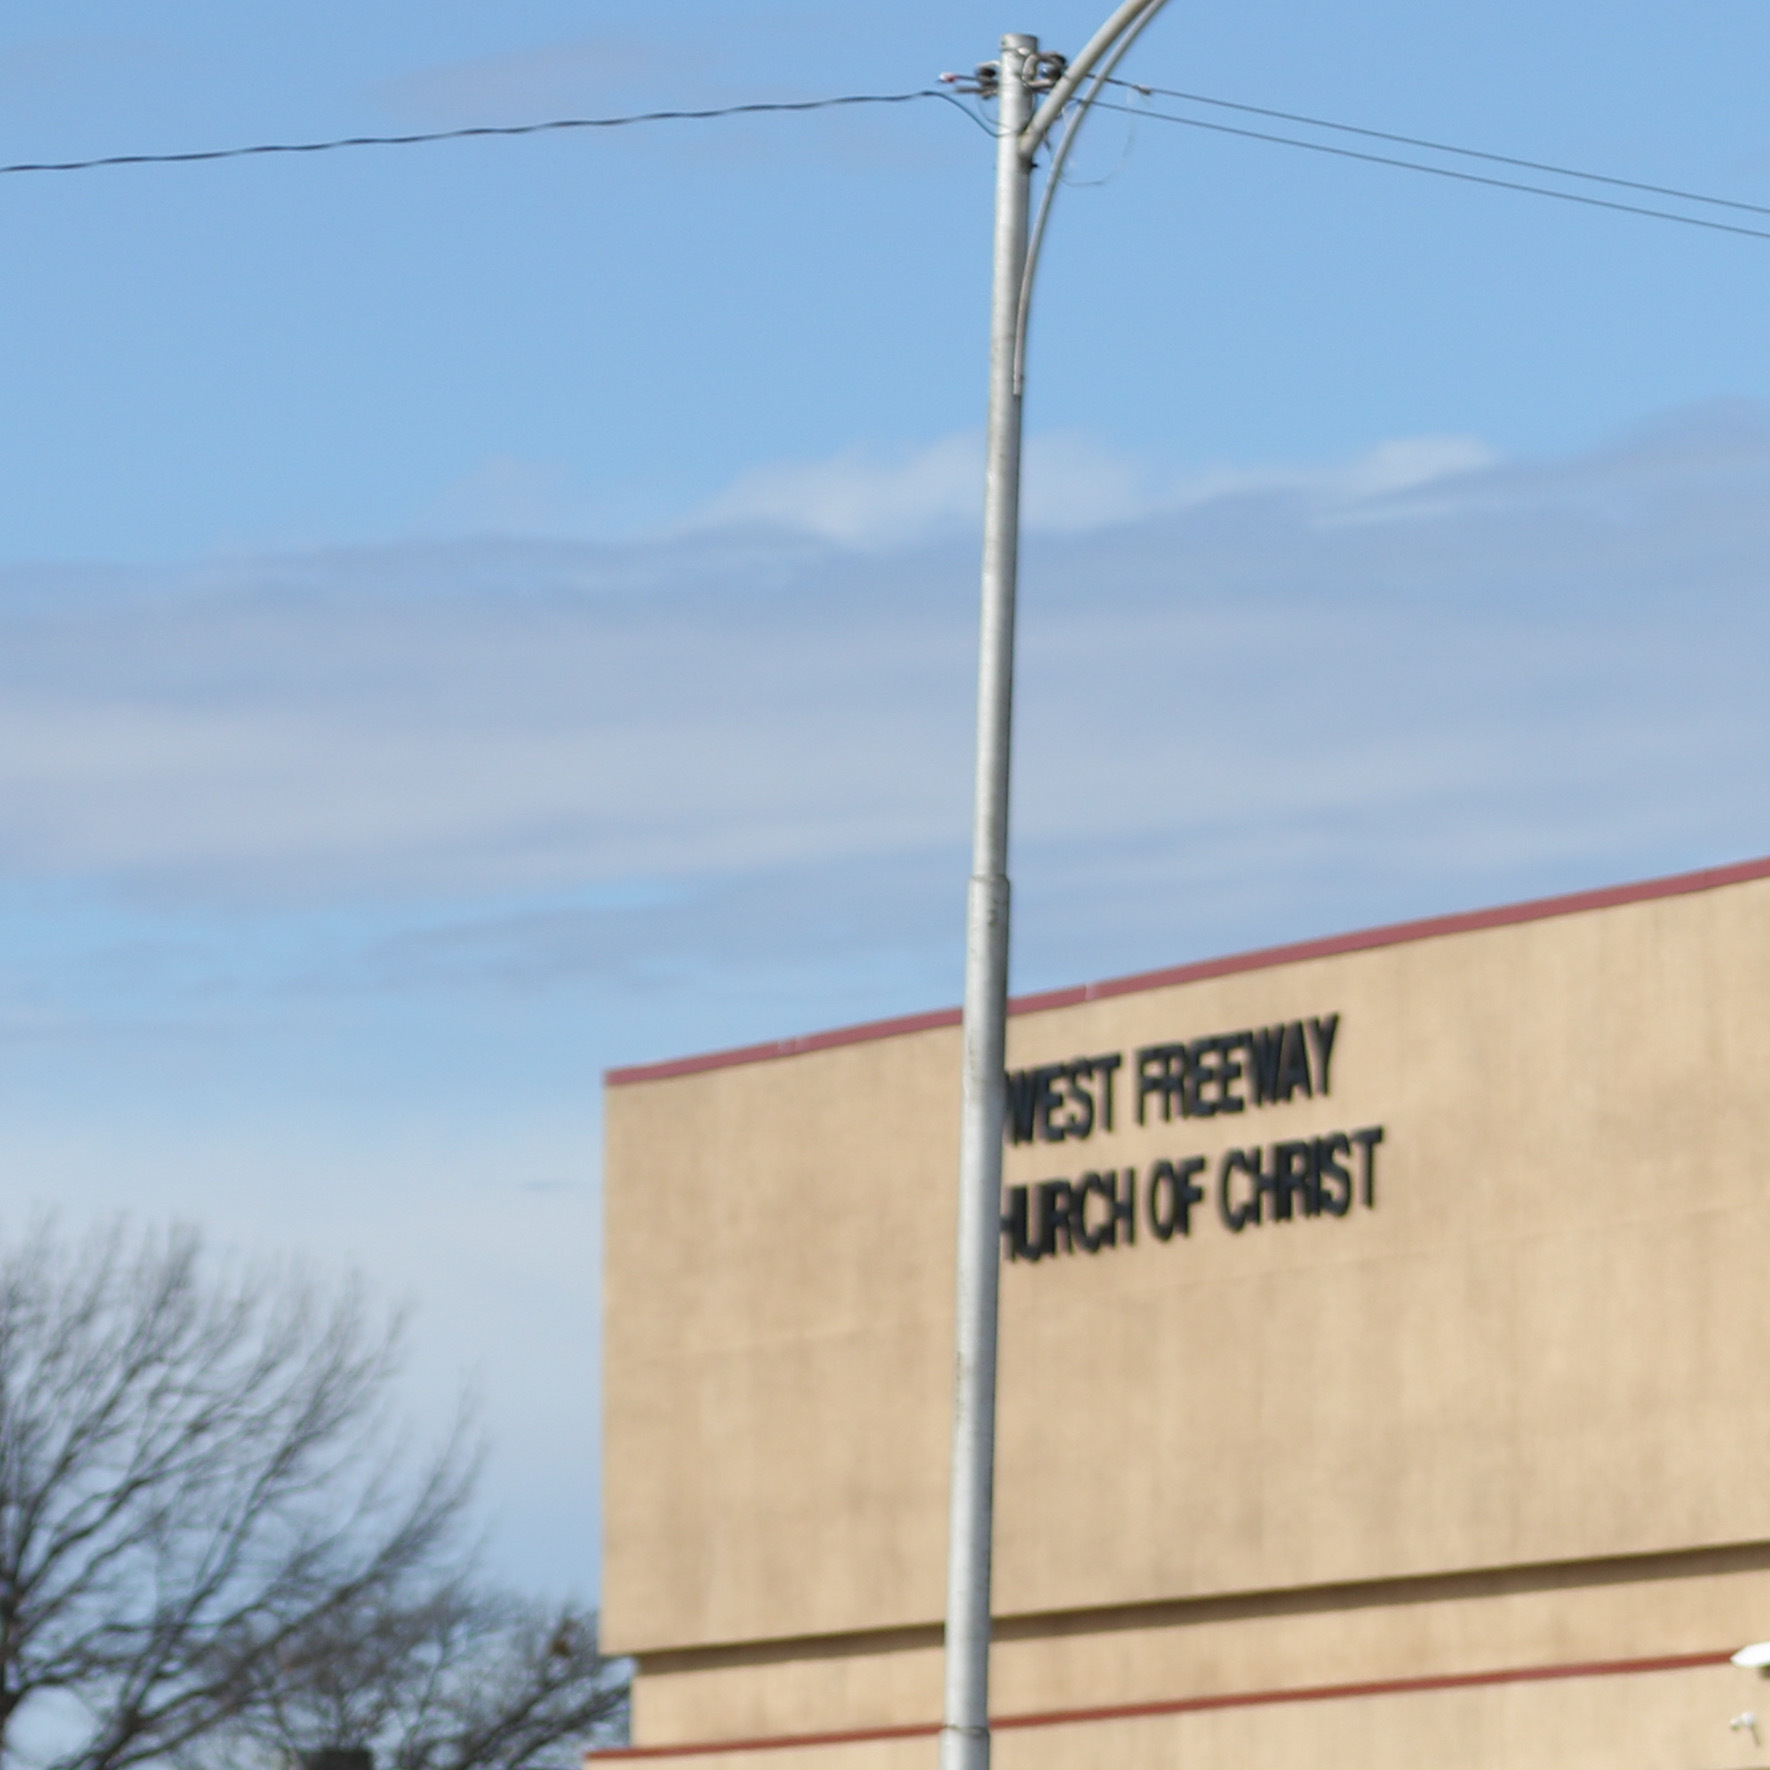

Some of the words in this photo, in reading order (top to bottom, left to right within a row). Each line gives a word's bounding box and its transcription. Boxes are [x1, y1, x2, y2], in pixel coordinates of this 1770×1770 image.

[1003, 1052, 1121, 1147] WEST
[1134, 1013, 1340, 1126] FREEWAY
[1000, 1167, 1135, 1263] HURCH
[1147, 1157, 1206, 1242] OF
[1218, 1126, 1385, 1234] CHRIST
